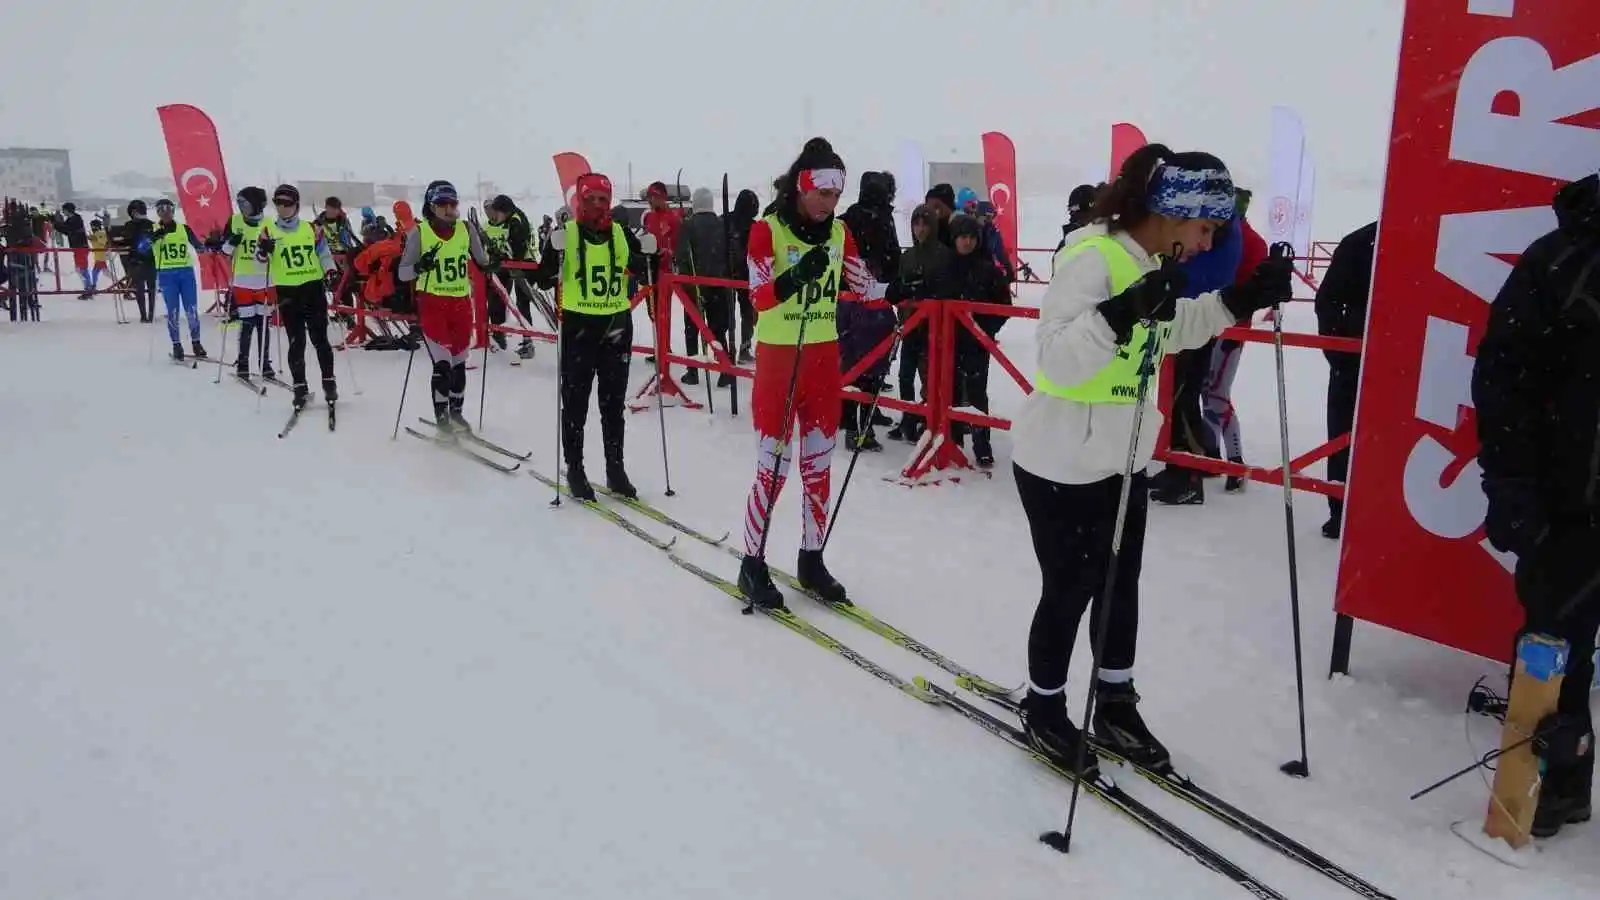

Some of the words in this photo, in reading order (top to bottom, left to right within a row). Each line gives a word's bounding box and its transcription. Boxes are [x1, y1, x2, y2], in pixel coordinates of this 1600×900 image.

[161, 244, 186, 259] 159
[241, 240, 256, 253] 15
[281, 245, 313, 268] 157
[435, 255, 467, 283] 156
[575, 266, 623, 300] 155
[1403, 0, 1600, 574] STAR
